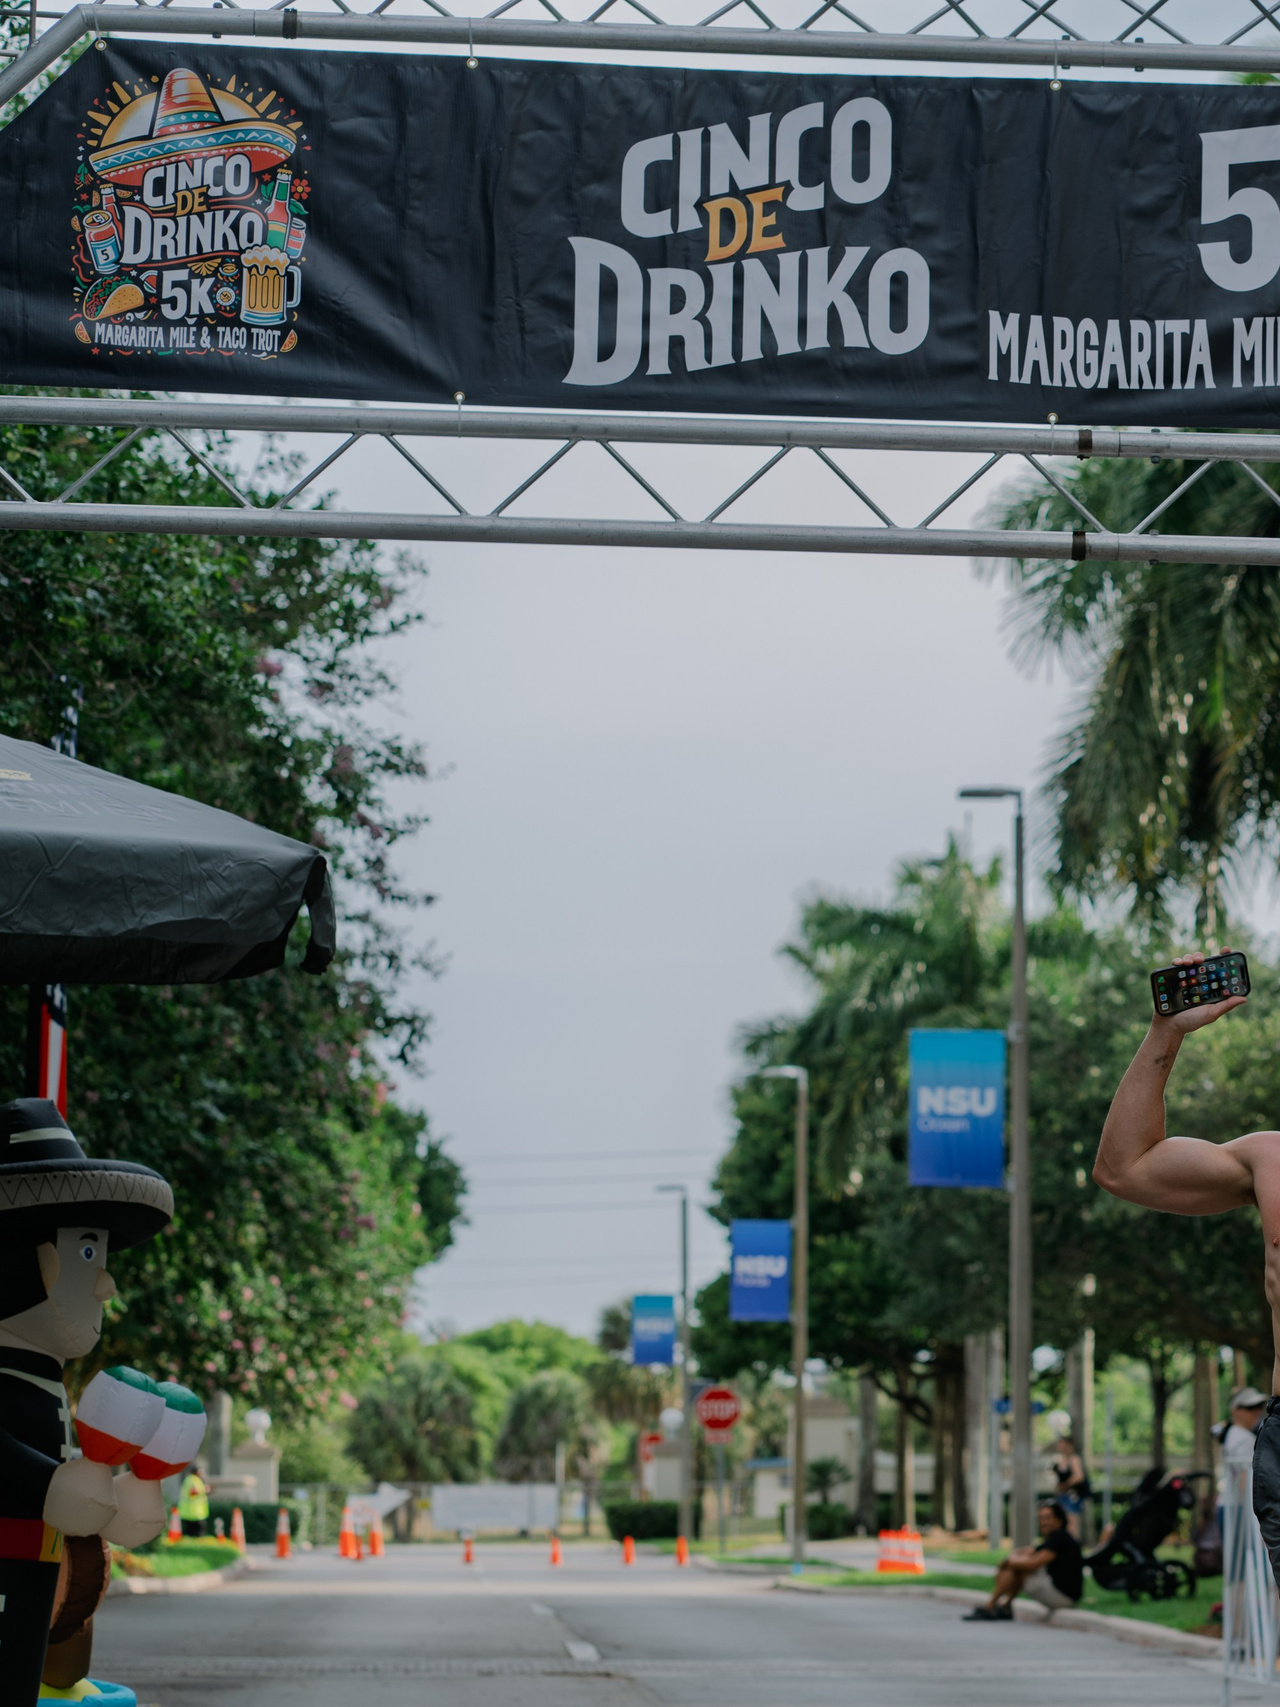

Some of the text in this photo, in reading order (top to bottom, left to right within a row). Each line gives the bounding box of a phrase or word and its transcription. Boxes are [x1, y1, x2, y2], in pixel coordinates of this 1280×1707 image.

[143, 153, 251, 208] CINCO
[620, 97, 893, 238] CINCO
[174, 185, 211, 217] DE
[702, 185, 787, 262] DE
[100, 249, 110, 261] 5
[120, 205, 264, 265] DRINKO
[161, 268, 216, 320] 5K
[561, 236, 930, 386] DRINKO
[94, 322, 281, 352] MARGARITA MILE & TACO TROT
[987, 310, 1216, 390] MARGARITA
[917, 1086, 997, 1118] NSU
[700, 1399, 737, 1420] STOP
